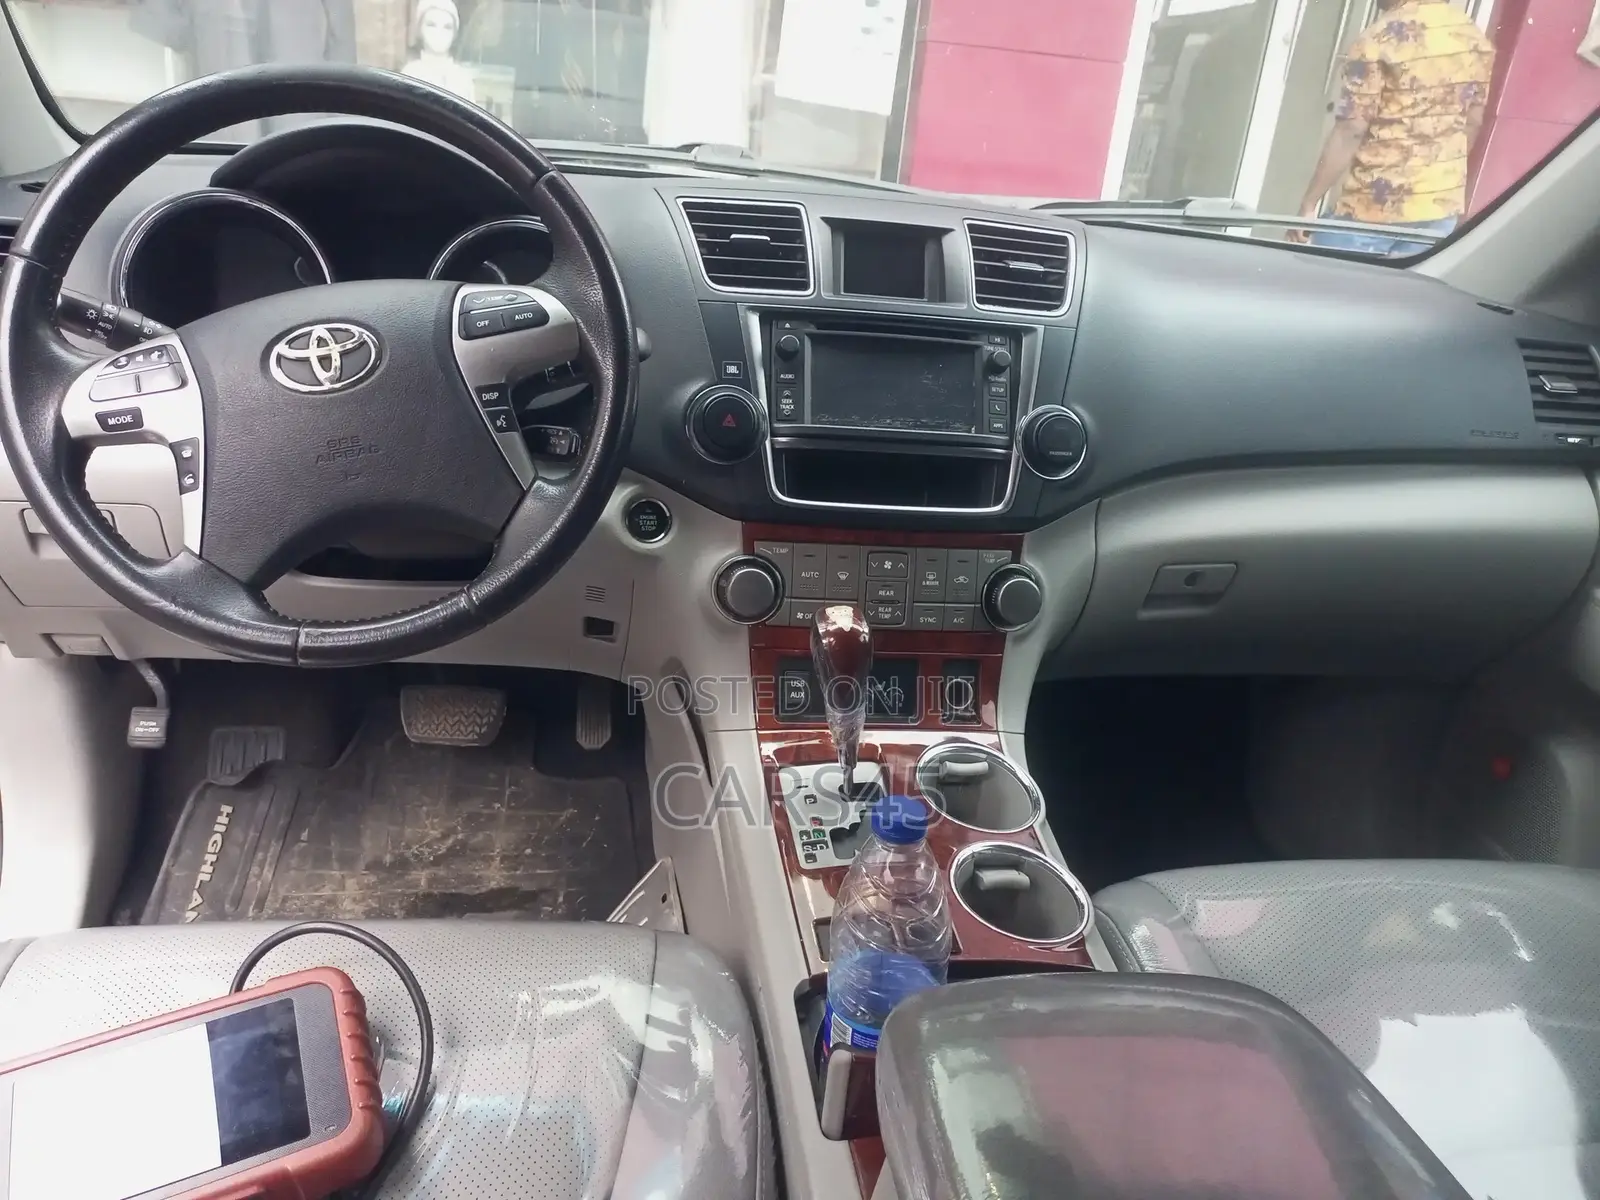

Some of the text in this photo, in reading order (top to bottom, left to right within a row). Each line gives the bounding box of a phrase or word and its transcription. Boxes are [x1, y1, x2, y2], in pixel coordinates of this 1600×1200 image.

[514, 312, 533, 321] AUTO
[98, 321, 113, 330] AUTO
[476, 320, 490, 328] OFF
[482, 392, 499, 401] DISP
[107, 415, 134, 426] MODE
[919, 616, 937, 624] SYNC
[953, 616, 965, 624] A/C
[790, 680, 805, 688] USB
[814, 831, 825, 840] N
